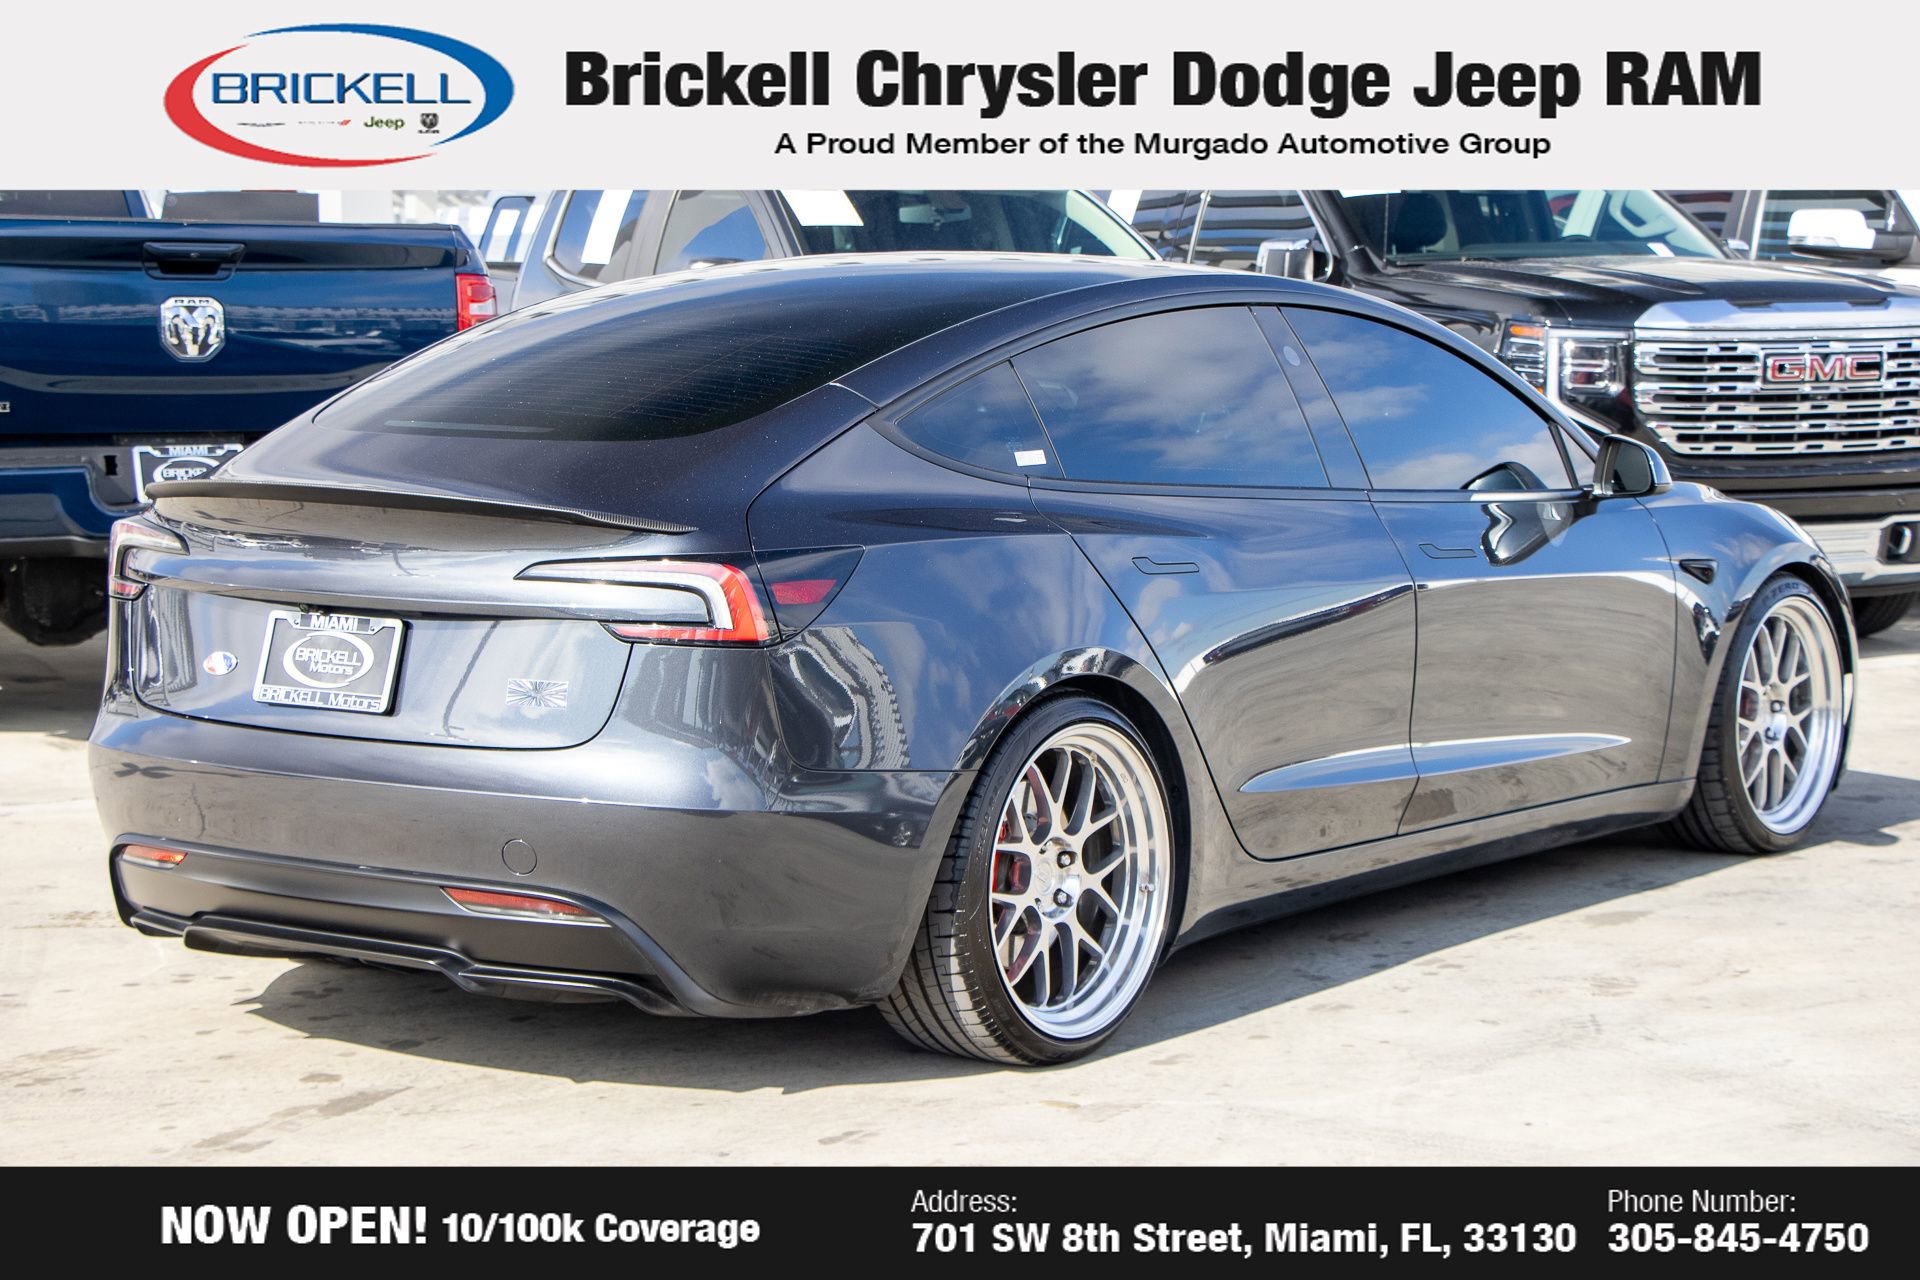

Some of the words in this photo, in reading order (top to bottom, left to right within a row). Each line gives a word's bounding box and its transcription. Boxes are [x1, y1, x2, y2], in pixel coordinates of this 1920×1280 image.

[1766, 354, 1880, 381] GMC
[168, 445, 209, 456] MIAMI
[310, 615, 358, 631] MIAMI
[295, 647, 361, 666] BRICKELL
[309, 663, 354, 675] Motors
[260, 686, 323, 704] BRICKELL
[328, 693, 381, 710] Motors
